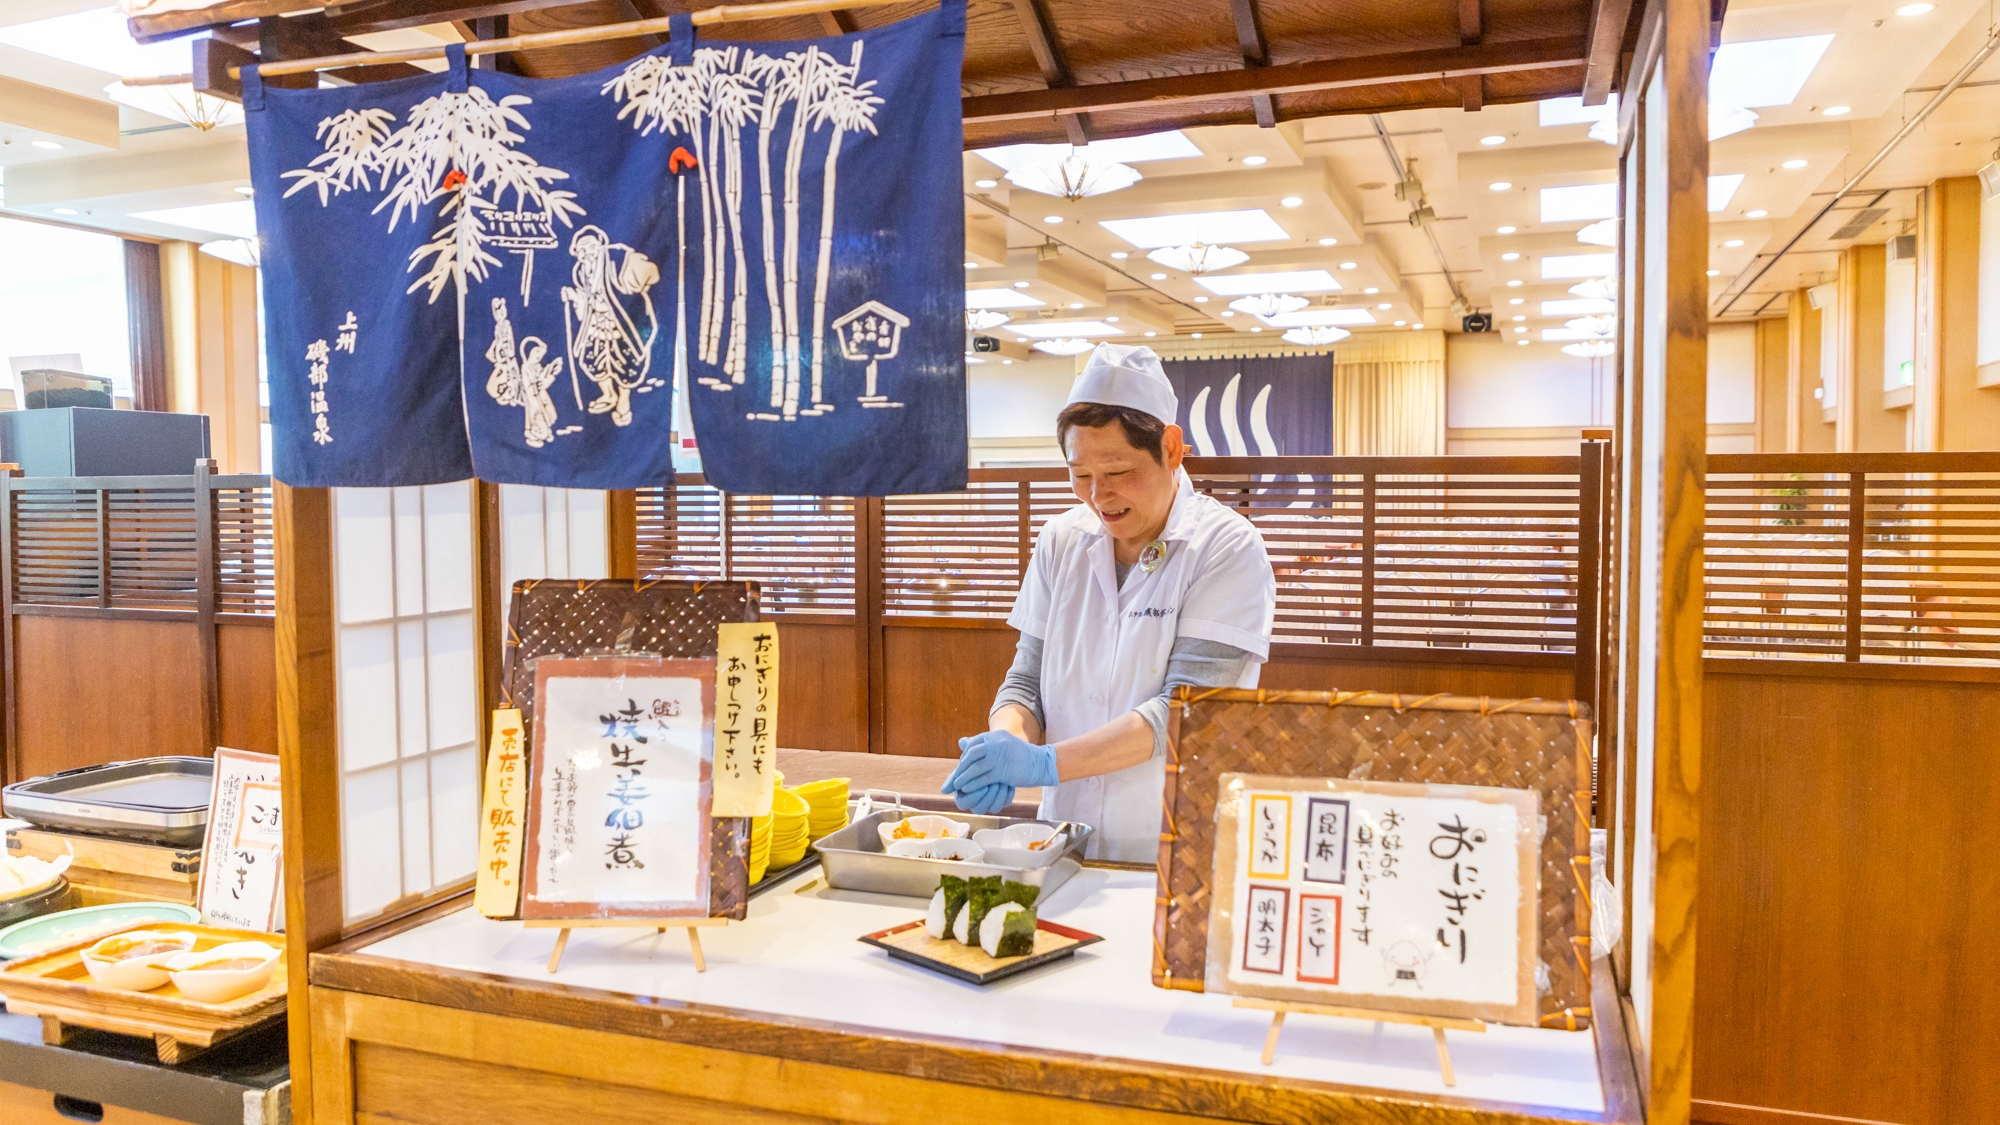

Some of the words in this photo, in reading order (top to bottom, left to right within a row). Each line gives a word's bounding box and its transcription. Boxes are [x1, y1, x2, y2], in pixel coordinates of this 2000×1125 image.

[335, 311, 358, 354] 上州
[305, 338, 334, 446] 磯部温泉
[722, 655, 747, 779] お申しつけ下さい。
[752, 632, 773, 776] おにぎりの具にも
[251, 804, 280, 826] ごま
[488, 726, 521, 887] 売店にて販売中。
[599, 698, 652, 870] 焼生姜佃煮
[1261, 805, 1278, 864] しょうが
[1316, 812, 1337, 862] 昆布
[1379, 808, 1405, 879] お好みの
[1253, 899, 1277, 957] 明太子
[1430, 813, 1487, 964] おにぎり
